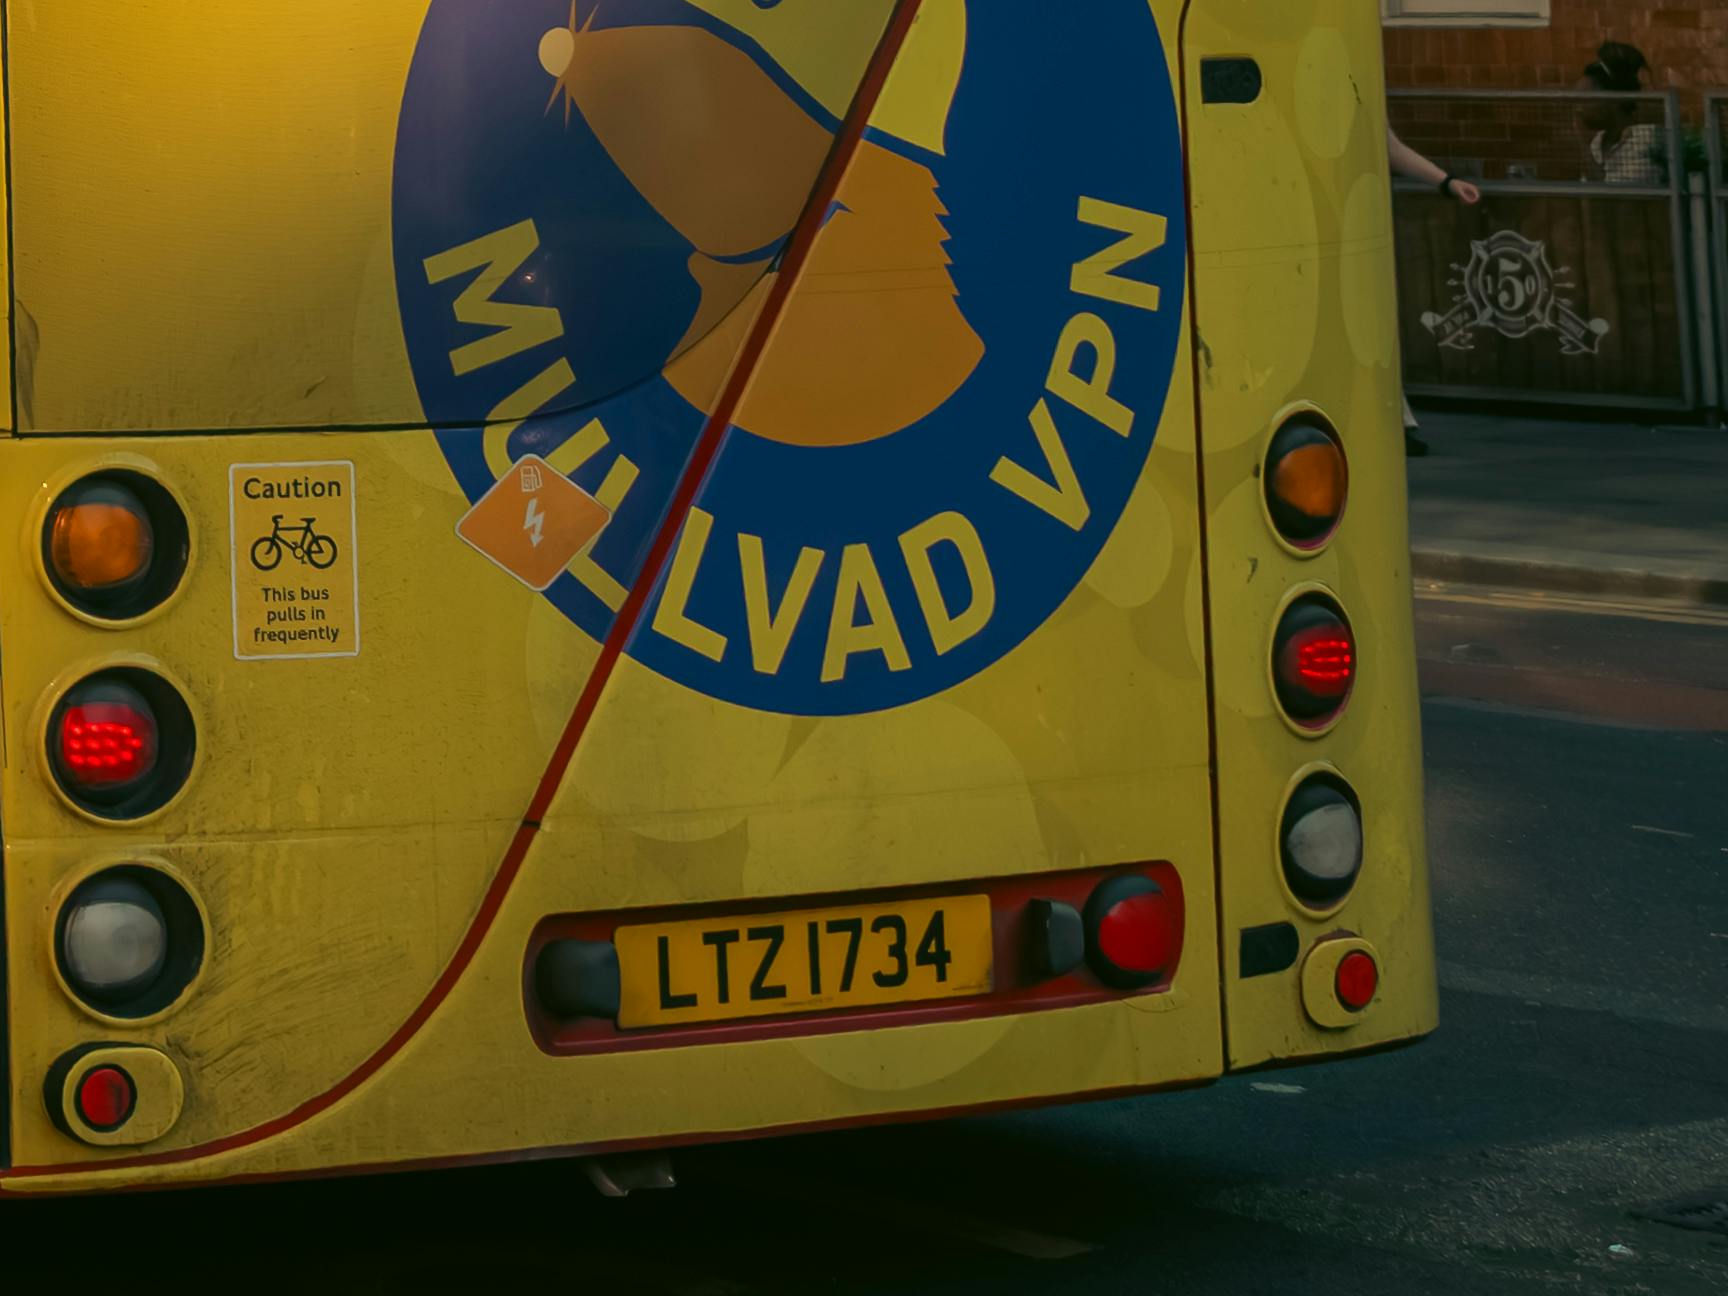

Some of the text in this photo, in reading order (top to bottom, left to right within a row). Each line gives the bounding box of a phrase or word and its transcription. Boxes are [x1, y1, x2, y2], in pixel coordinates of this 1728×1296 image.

[423, 195, 1168, 683] MULLVAD VPN
[244, 476, 341, 499] Caution
[261, 586, 329, 602] This bus
[267, 606, 325, 624] pulls in
[253, 625, 339, 644] frequently
[657, 909, 952, 1010] LTZ 1734
